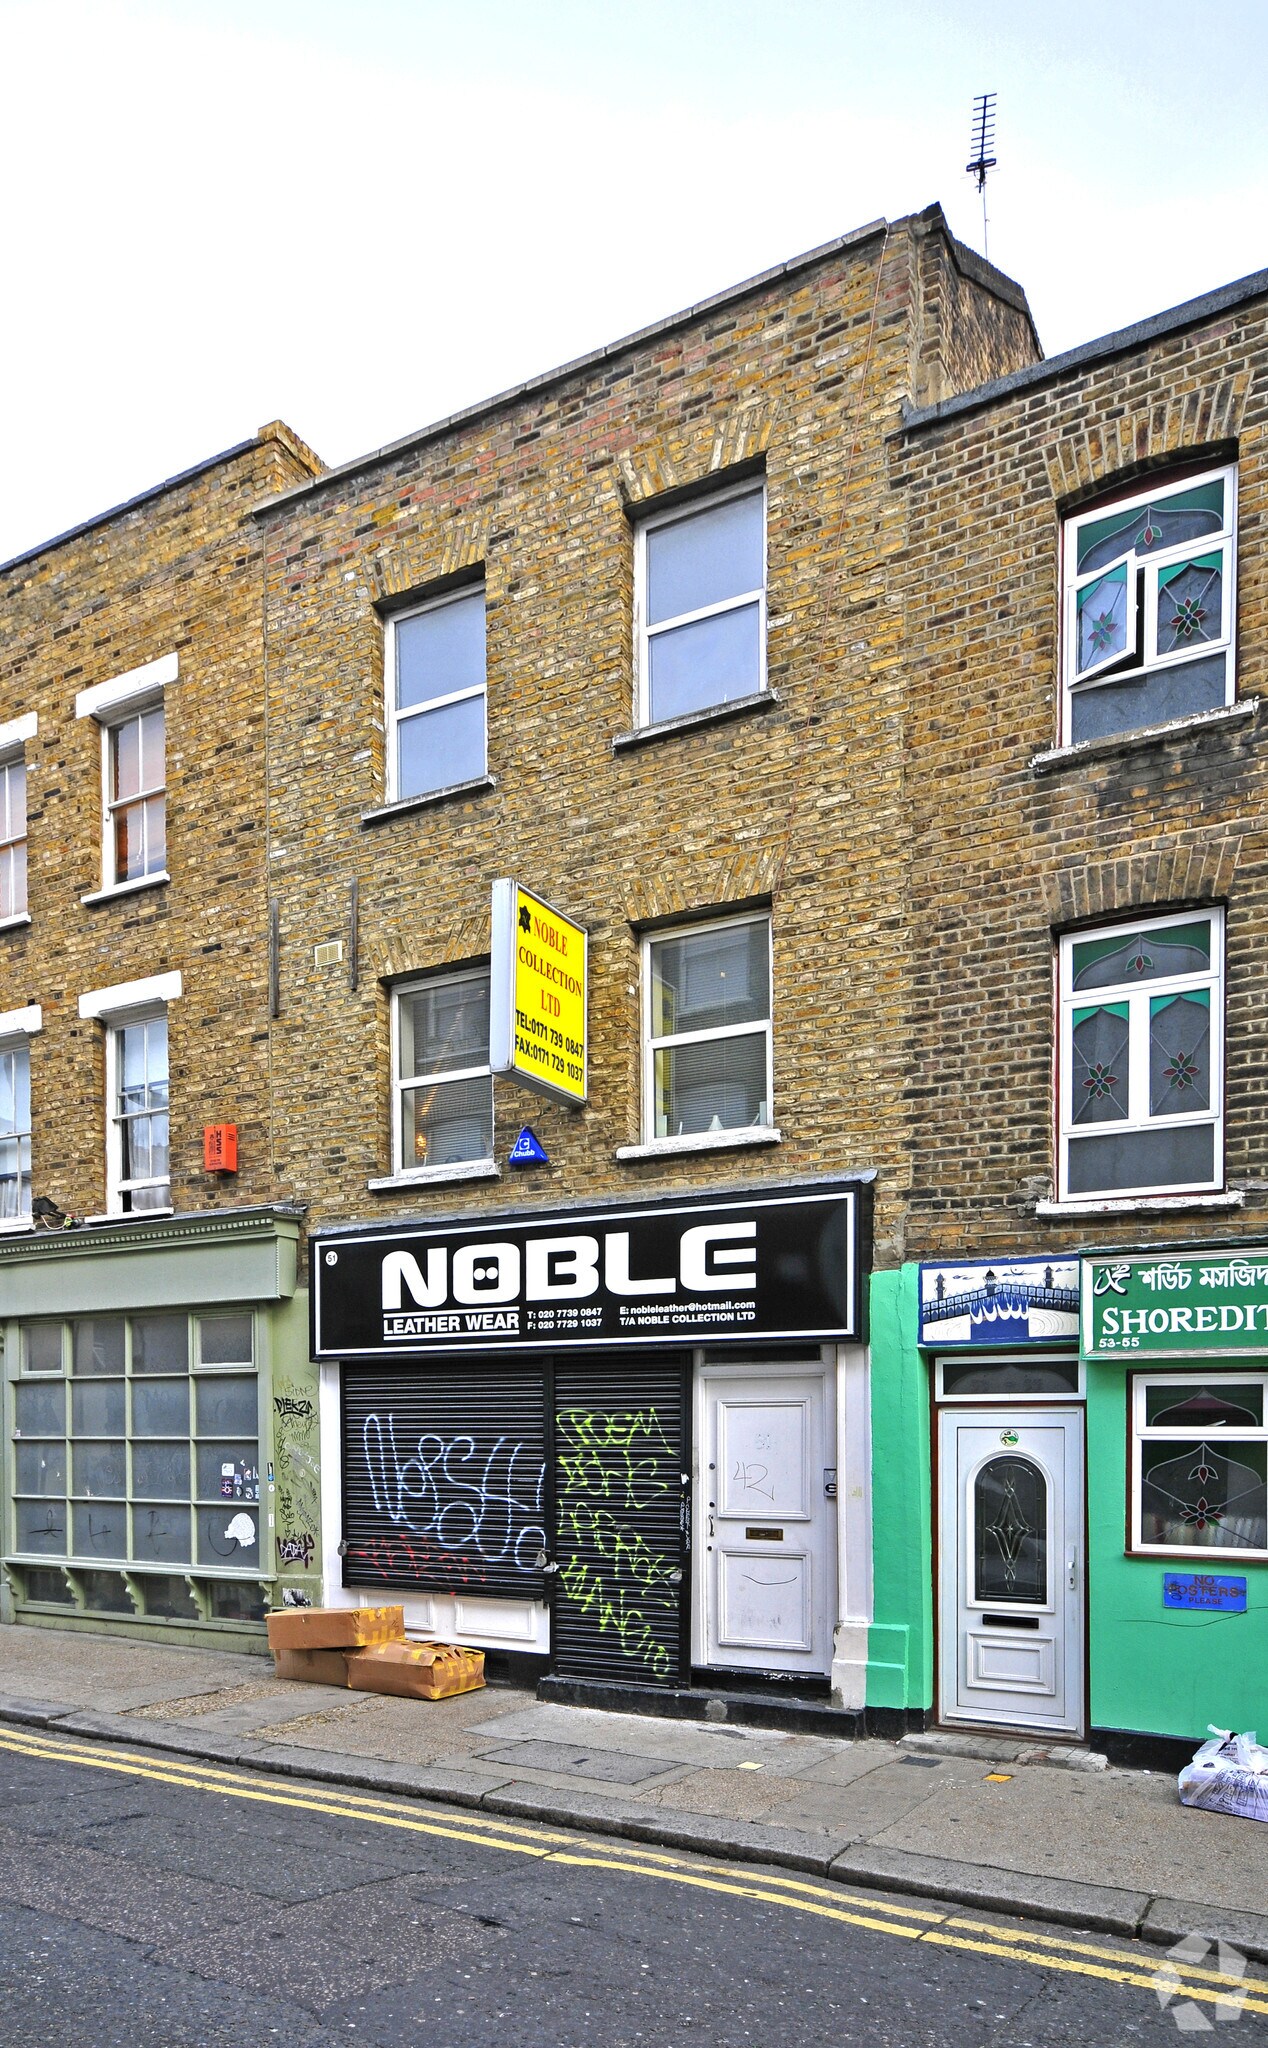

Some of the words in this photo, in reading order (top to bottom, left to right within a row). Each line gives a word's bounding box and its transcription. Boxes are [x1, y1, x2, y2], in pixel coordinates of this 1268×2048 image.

[533, 916, 568, 957] NOBLE
[518, 946, 582, 998] COLLECTION
[541, 988, 561, 1018] LTD
[515, 1009, 548, 1041] TEL:0171
[550, 1028, 563, 1049] 739
[565, 1036, 584, 1059] 0847
[515, 1033, 550, 1067] FAX:0171
[551, 1053, 565, 1073] 729
[567, 1062, 583, 1082] 1037
[514, 1149, 536, 1158] Chubb
[327, 1254, 336, 1262] 51
[382, 1221, 757, 1309] NOBLE
[527, 1311, 537, 1319] T:
[538, 1310, 555, 1318] 020
[556, 1308, 579, 1318] 7739
[580, 1307, 603, 1317] 0847
[619, 1306, 630, 1315] E:
[631, 1301, 756, 1315] nobleleather@hotmail.com
[383, 1315, 460, 1335] LEATHER
[466, 1312, 520, 1331] WEAR
[527, 1321, 537, 1330] F:
[538, 1320, 555, 1329] 020
[556, 1319, 579, 1328] 7729
[581, 1318, 603, 1327] 1037
[619, 1316, 636, 1326] T/A
[637, 1315, 670, 1325] NOBLE
[672, 1313, 735, 1324] COLLECTION
[737, 1311, 756, 1321] LTD
[1098, 1337, 1140, 1348] 53-55
[1194, 1575, 1215, 1586] NO
[1168, 1583, 1239, 1597] POSTERS
[1189, 1597, 1223, 1605] PLEASE
